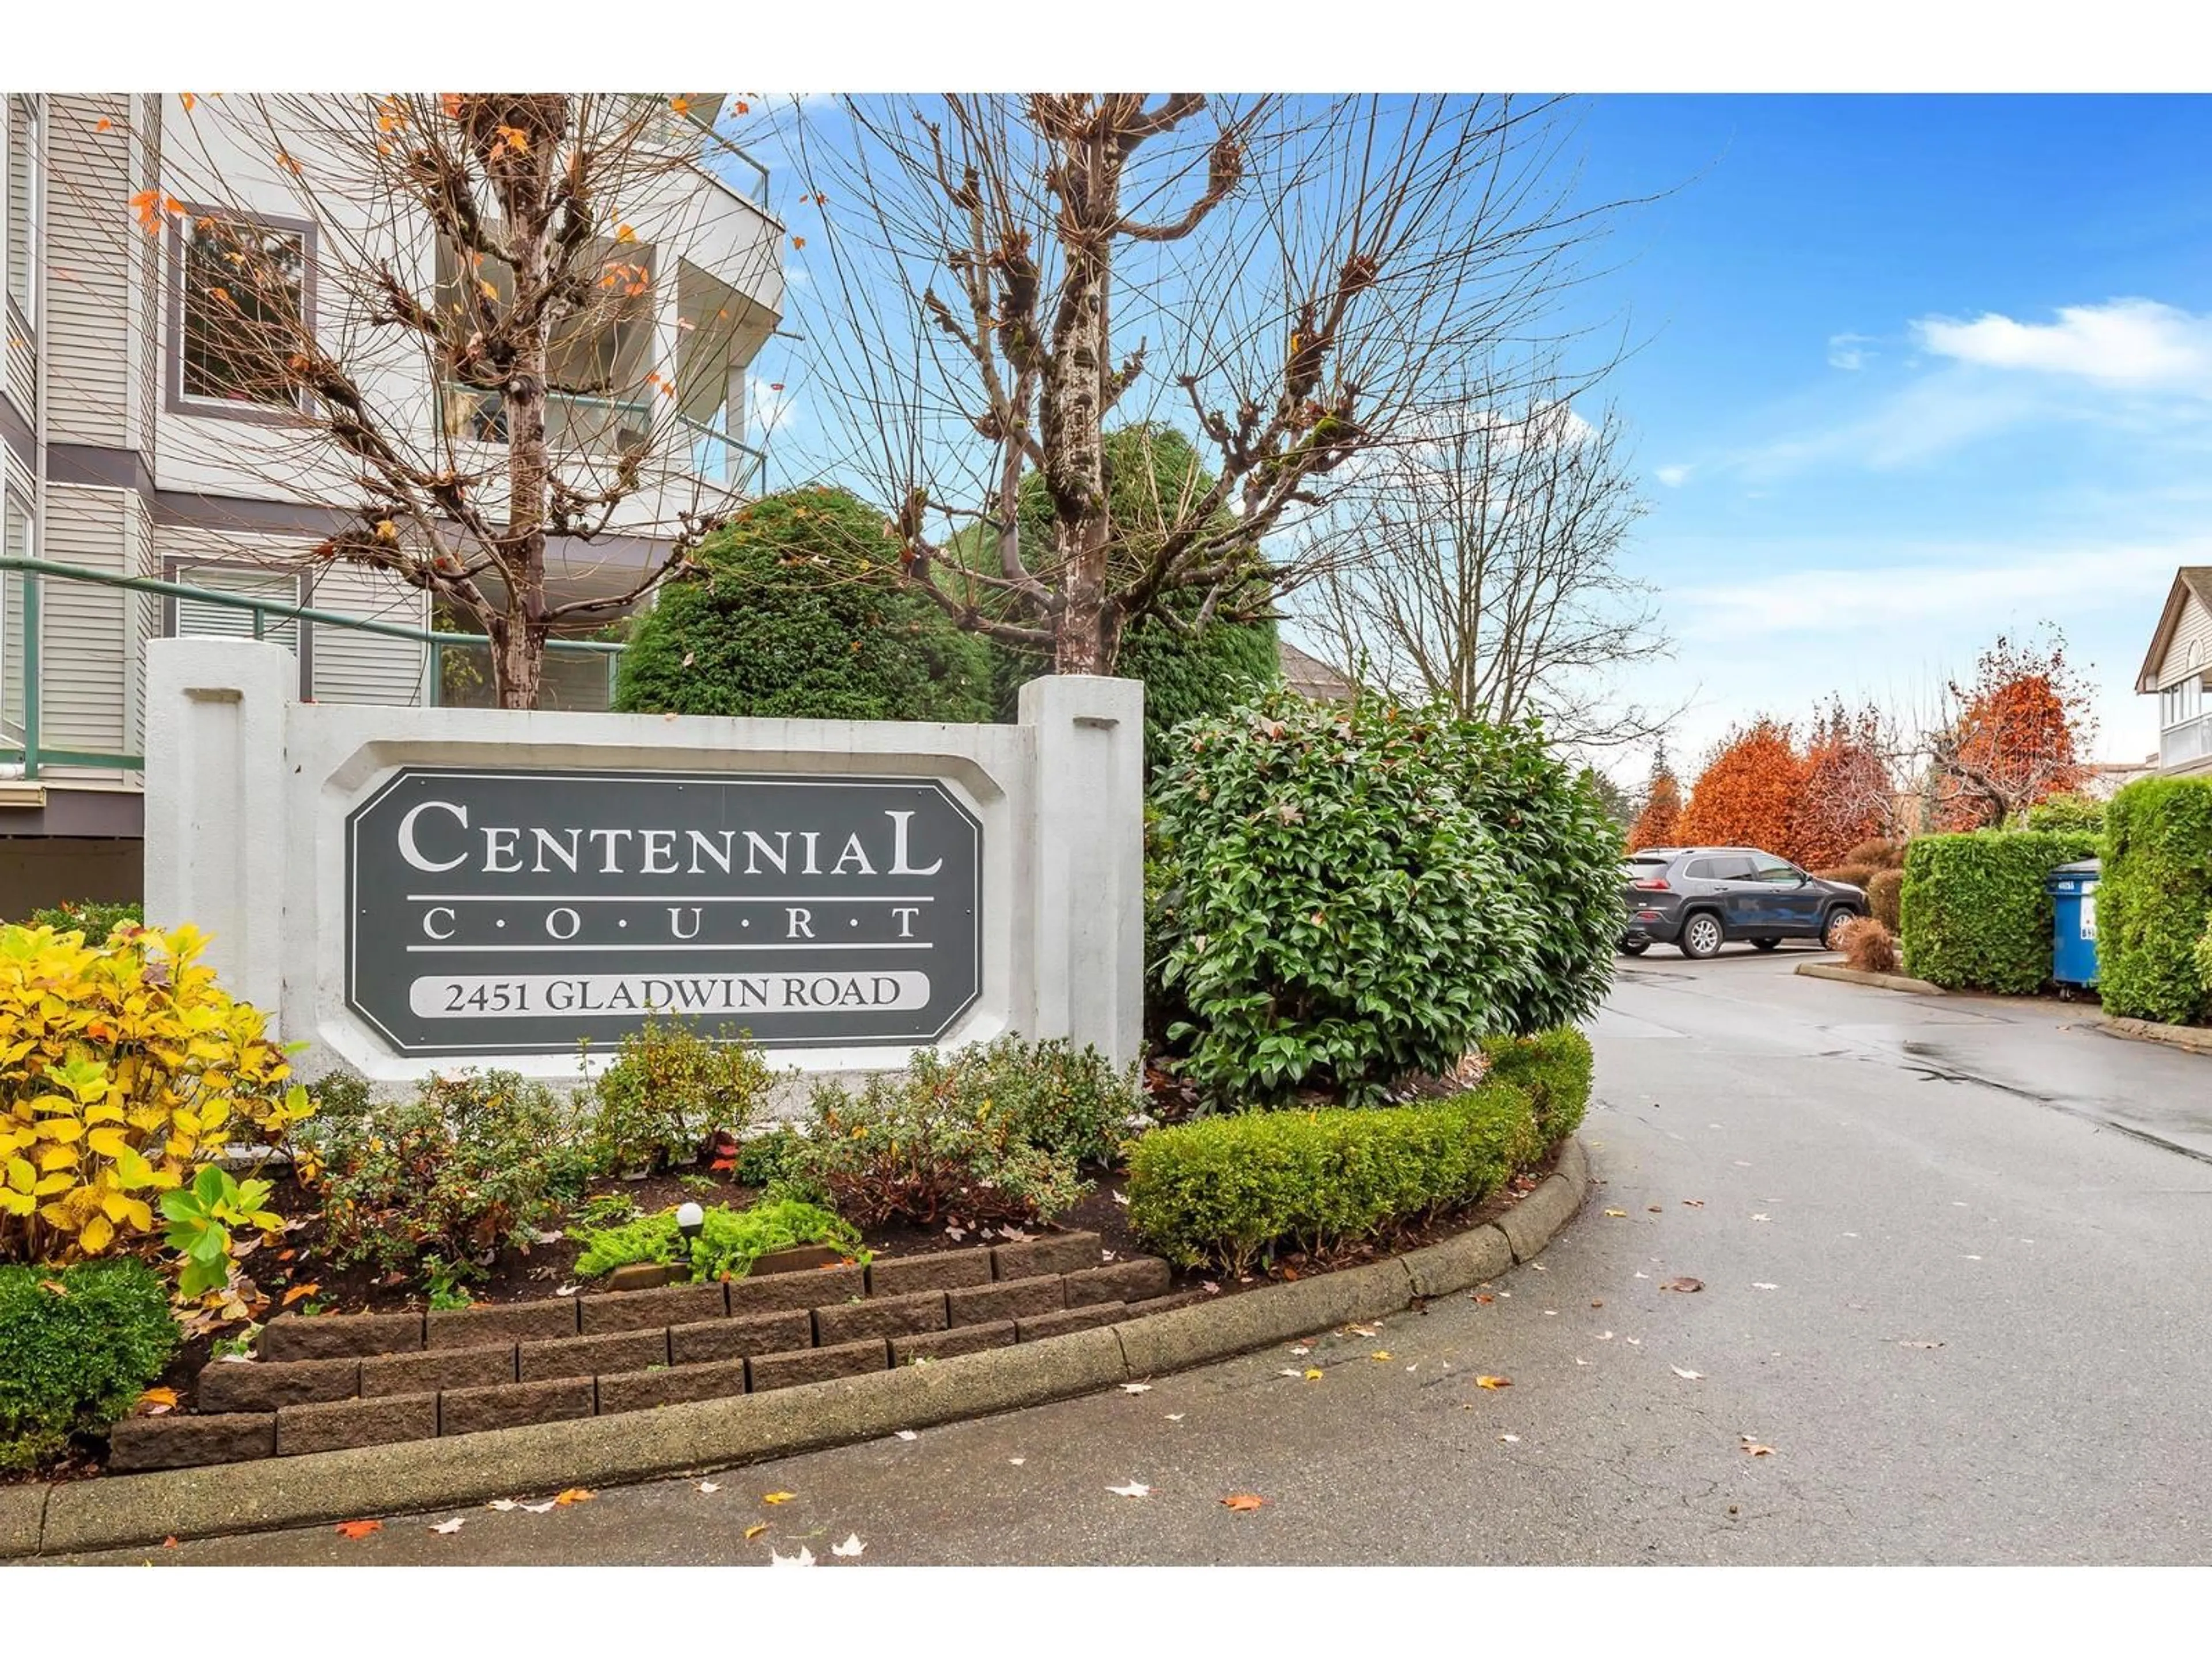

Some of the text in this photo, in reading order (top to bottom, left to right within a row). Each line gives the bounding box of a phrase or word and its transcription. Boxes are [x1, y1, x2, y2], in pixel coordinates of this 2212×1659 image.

[397, 801, 943, 876] CENTENNIAL
[444, 977, 901, 1012] 2451 GLADWIN ROAD
